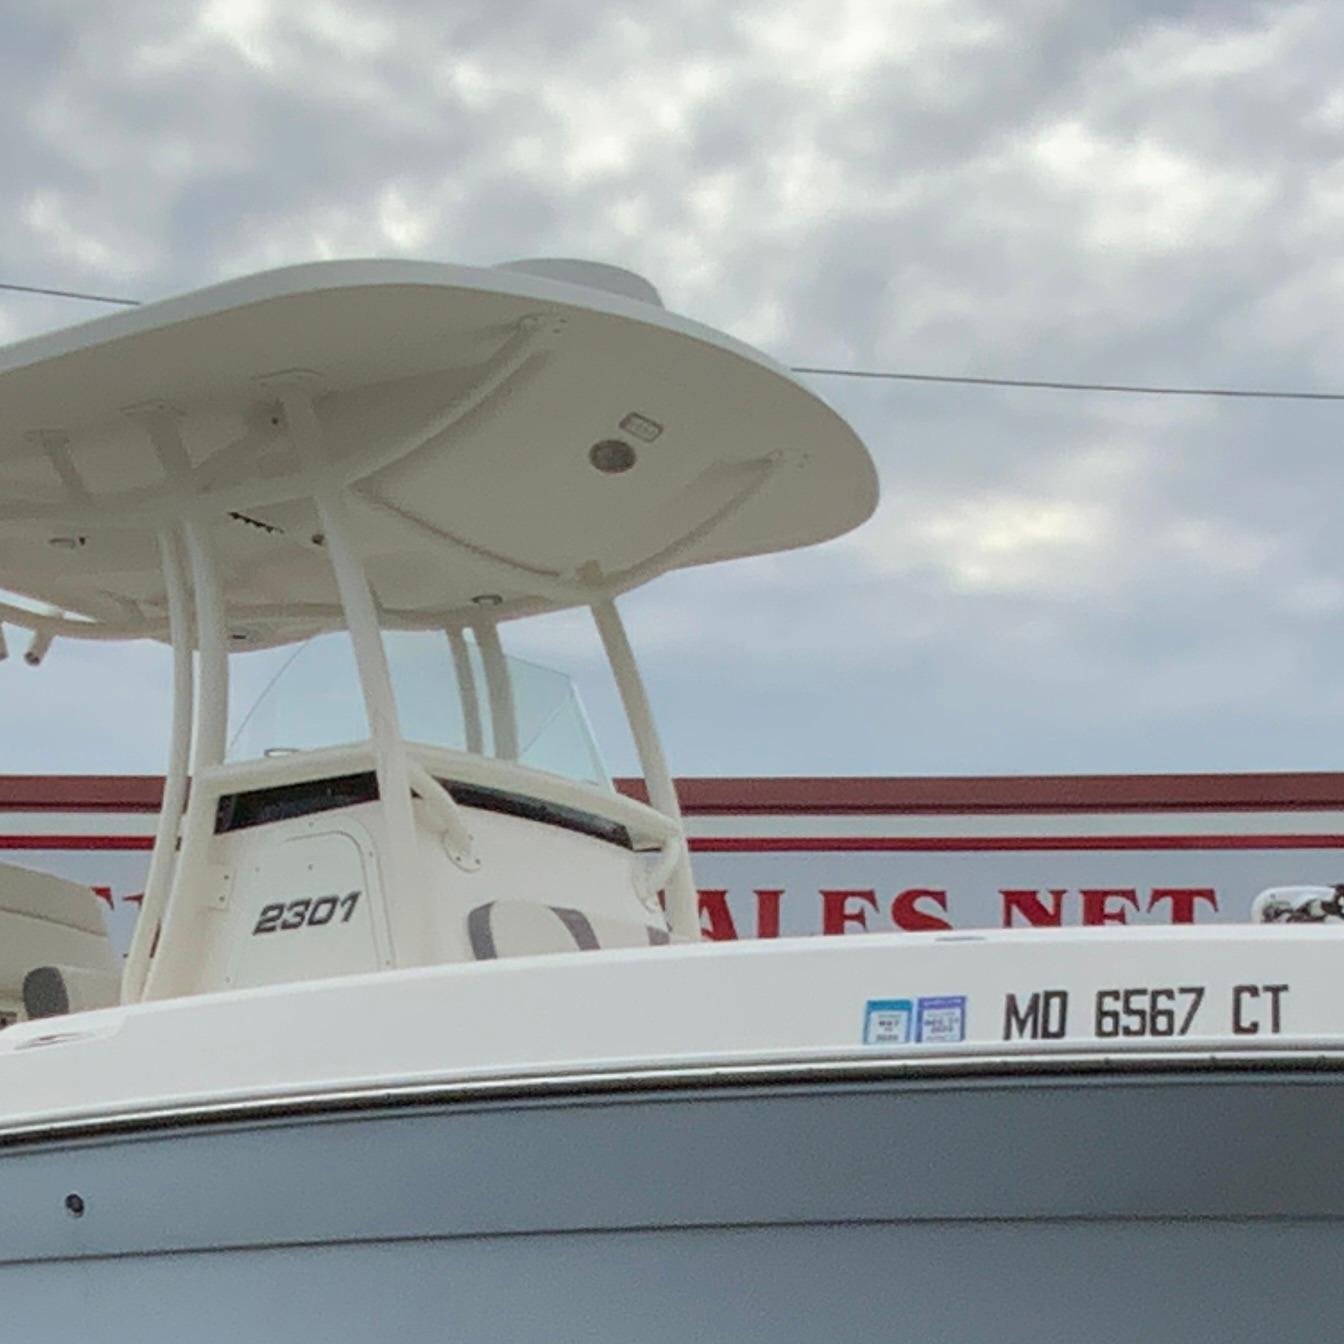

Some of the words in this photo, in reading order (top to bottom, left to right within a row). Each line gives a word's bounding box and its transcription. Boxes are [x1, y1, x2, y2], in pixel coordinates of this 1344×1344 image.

[252, 890, 362, 936] 2301
[1002, 990, 1068, 1040] MD
[1094, 987, 1205, 1038] 6567
[1233, 984, 1289, 1034] CT
